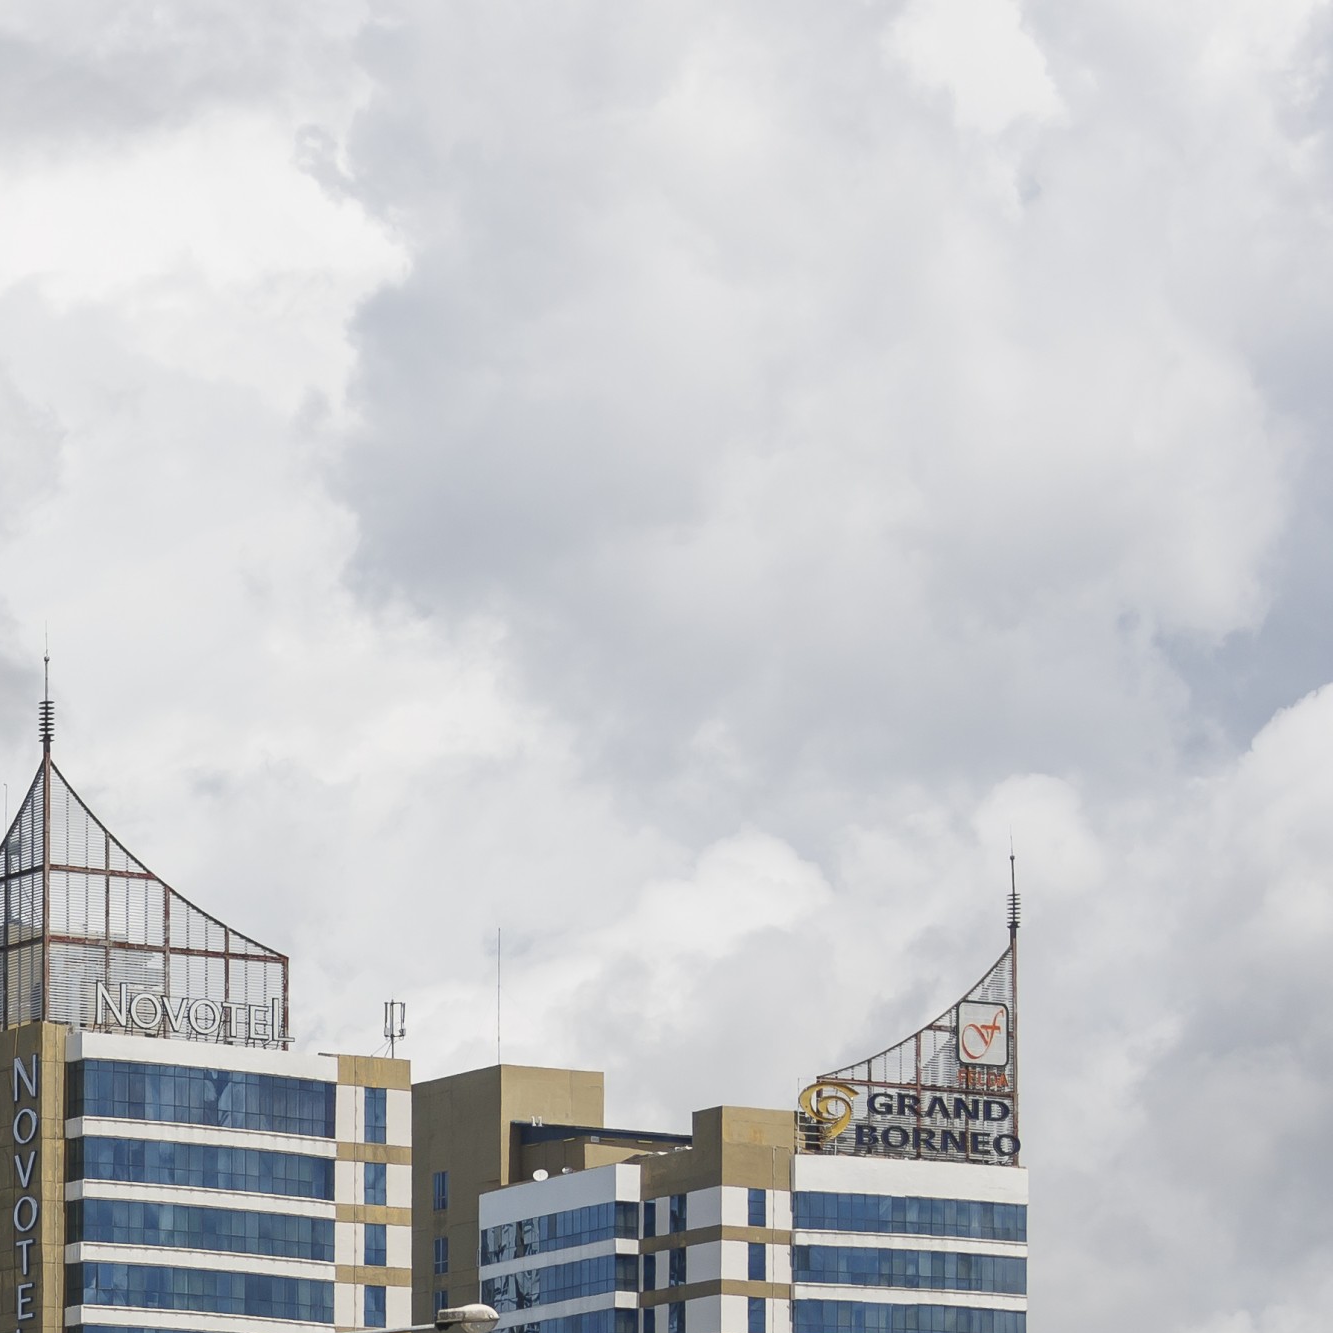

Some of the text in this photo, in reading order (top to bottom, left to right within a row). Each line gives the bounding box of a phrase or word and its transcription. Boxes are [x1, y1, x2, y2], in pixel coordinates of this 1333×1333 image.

[95, 981, 295, 1042] NOVOTEL
[957, 1069, 1009, 1087] FELDA
[867, 1092, 1010, 1121] GRAND
[854, 1124, 1021, 1156] BORNEO
